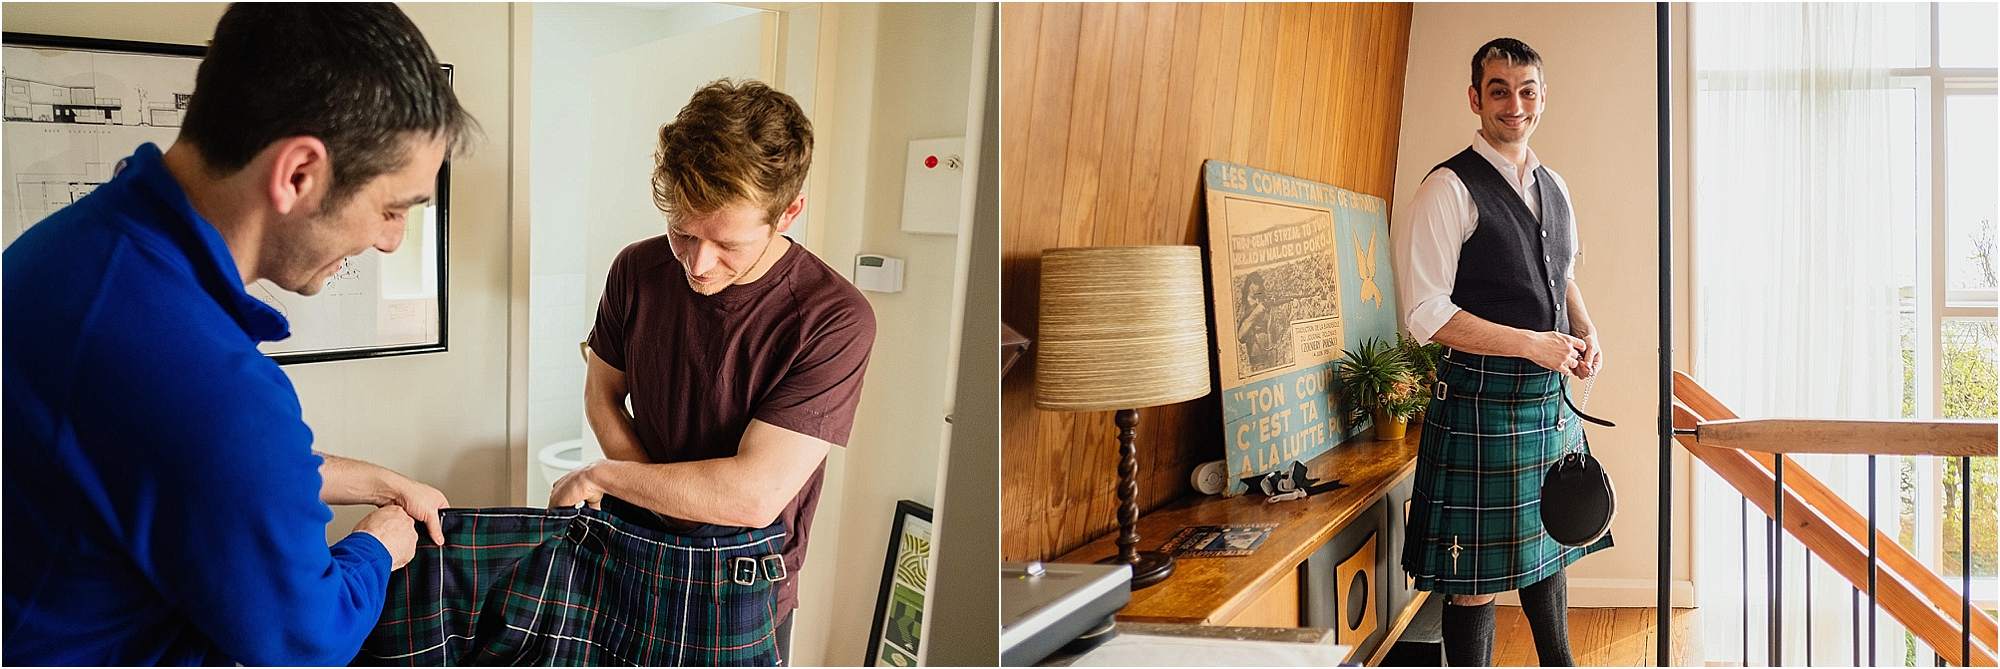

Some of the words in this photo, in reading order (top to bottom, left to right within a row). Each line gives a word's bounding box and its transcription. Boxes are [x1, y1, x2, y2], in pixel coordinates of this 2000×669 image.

[1221, 165, 1248, 191] LES
[1252, 172, 1337, 205] COMBATTANTS
[1337, 189, 1349, 208] DE
[1295, 242, 1302, 255] O
[1301, 223, 1312, 237] TO
[1295, 367, 1333, 400] COUP
[1237, 408, 1292, 451] C'EST
[1299, 400, 1319, 425] TA
[1258, 443, 1281, 473] LA
[1283, 421, 1325, 462] LUTTE
